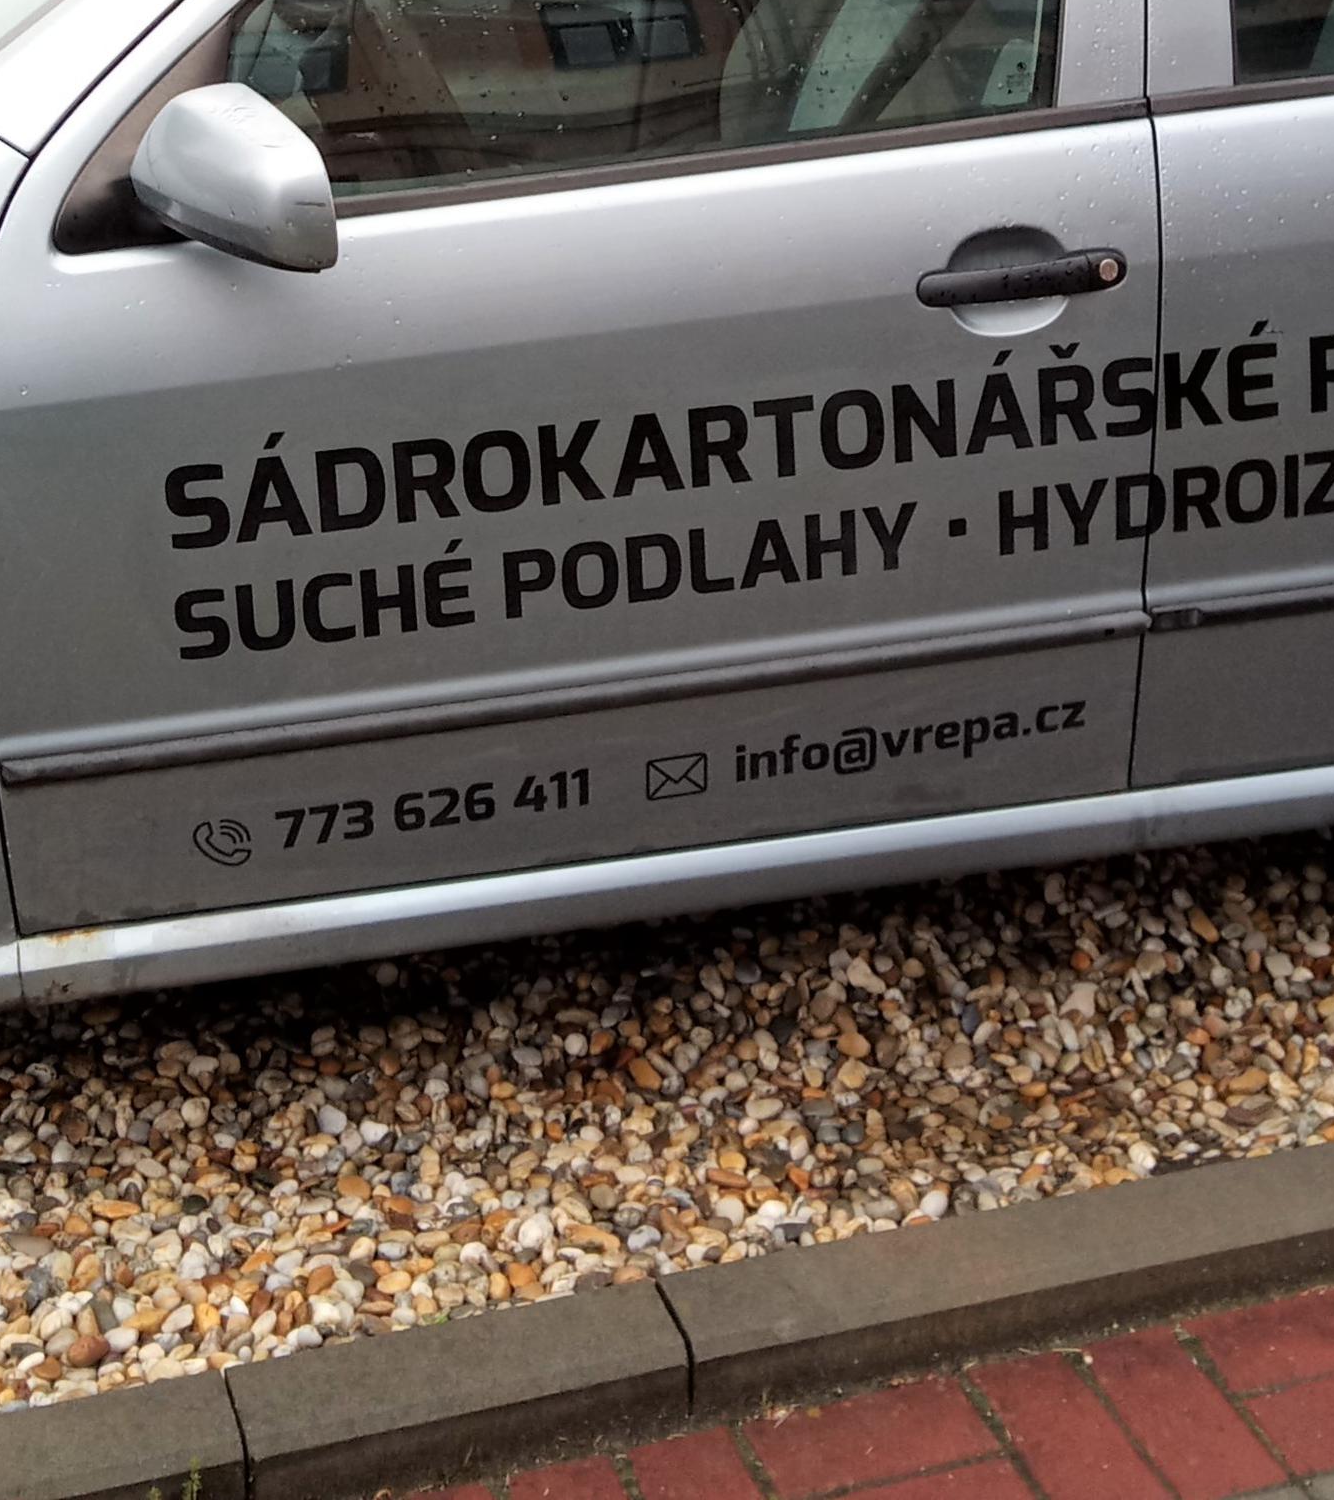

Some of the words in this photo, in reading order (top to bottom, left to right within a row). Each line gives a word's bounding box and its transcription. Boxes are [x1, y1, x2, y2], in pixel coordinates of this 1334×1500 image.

[165, 320, 1280, 550] SÁDROKARTONÁŘSKÉ
[174, 539, 476, 661] SUCHÉ
[502, 502, 918, 619] PODLAHY
[274, 800, 375, 849] 773
[394, 782, 496, 832] 626
[513, 768, 590, 812] 411
[735, 700, 1087, 782] info@vrepa.cz
